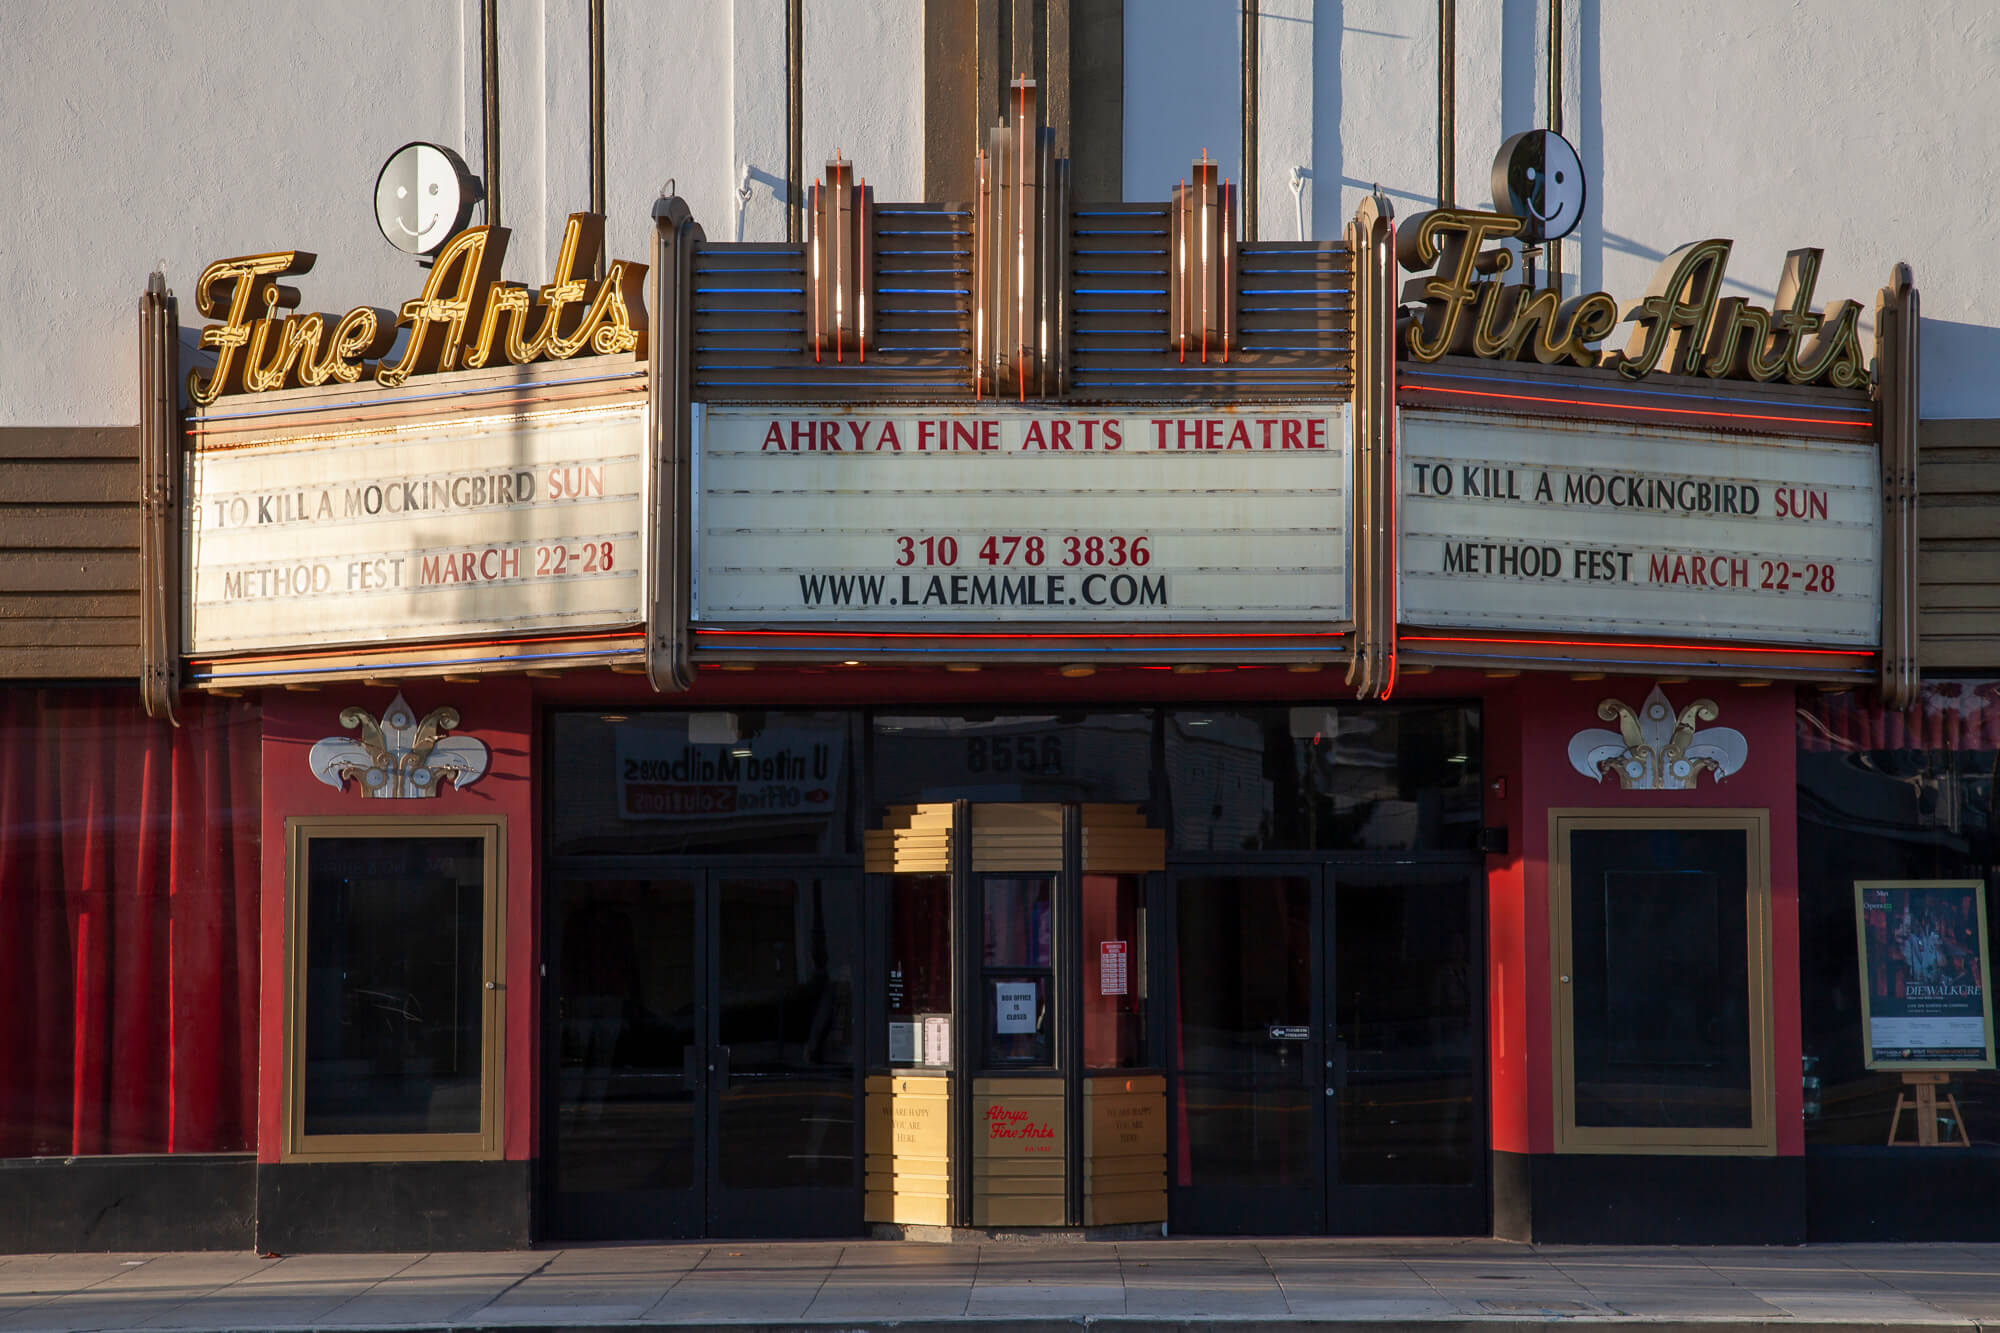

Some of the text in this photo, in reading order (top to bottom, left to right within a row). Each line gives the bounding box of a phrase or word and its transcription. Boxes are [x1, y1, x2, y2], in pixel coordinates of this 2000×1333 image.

[187, 212, 648, 406] Fine Arts
[1398, 208, 1871, 389] Fine Arts
[761, 418, 1327, 451] AHRYA FINE ARTS THEATRE
[214, 466, 604, 529] TO KILL A MOCKINGBIRD SUN
[1413, 462, 1829, 520] TO KILL A MOCKINGBIRD SUN
[224, 541, 614, 600] METHOD FEST MARCH 22-28
[895, 535, 1151, 567] 310 478 3836
[1443, 542, 1836, 593] METHOD FEST MARCH 22-28
[799, 574, 1168, 607] WWW.LAEMMLE.COM
[990, 1122, 1055, 1139] Fine Arts
